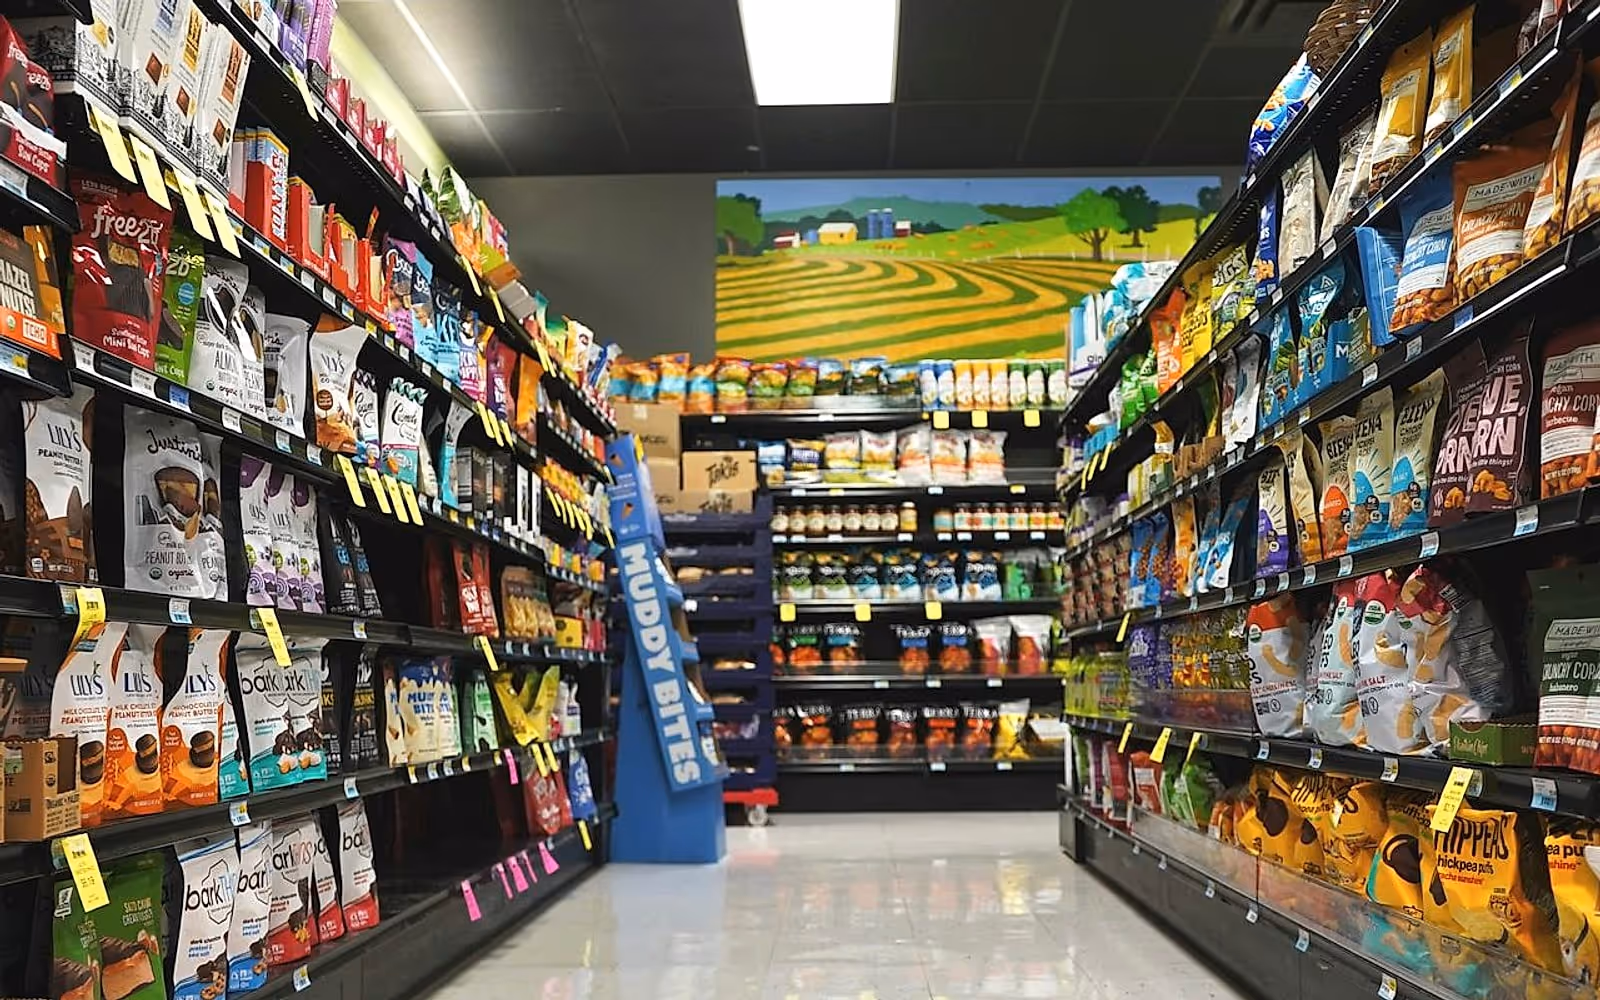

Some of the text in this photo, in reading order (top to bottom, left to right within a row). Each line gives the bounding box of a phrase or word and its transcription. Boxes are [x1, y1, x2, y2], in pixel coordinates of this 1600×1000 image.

[620, 542, 676, 673] MUDDY
[653, 678, 701, 785] BITES
[1368, 675, 1386, 686] SALT
